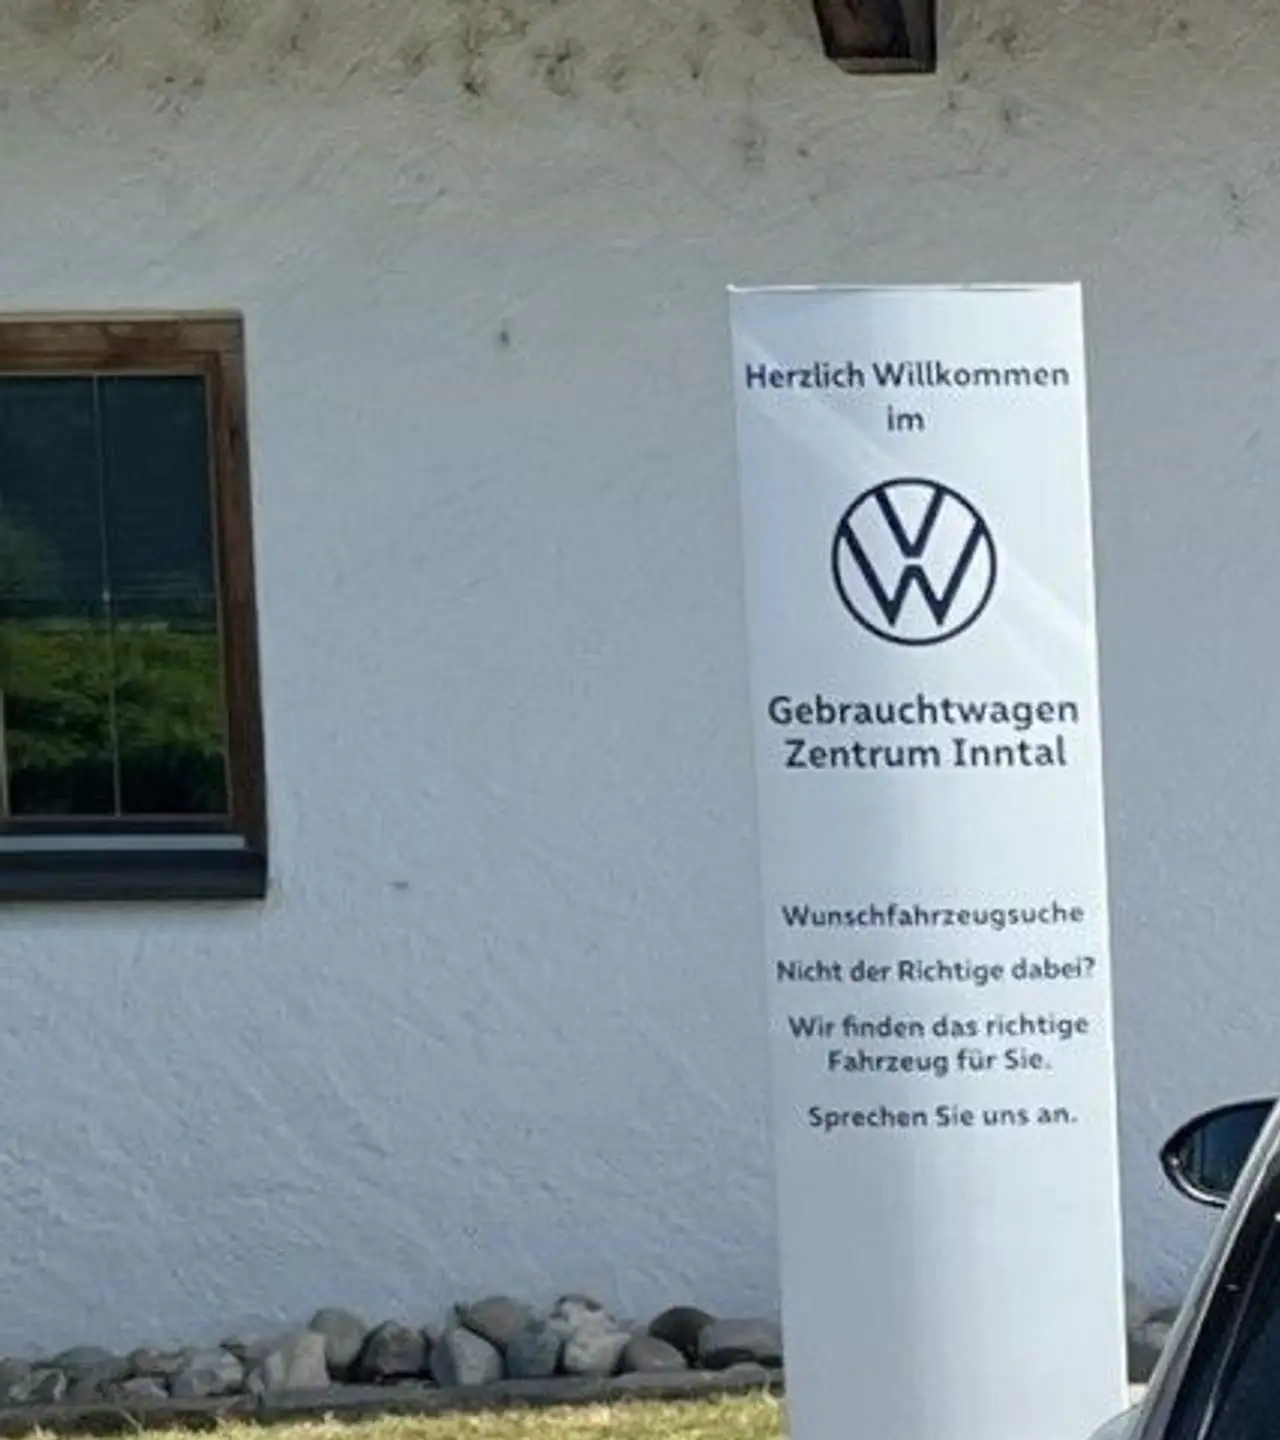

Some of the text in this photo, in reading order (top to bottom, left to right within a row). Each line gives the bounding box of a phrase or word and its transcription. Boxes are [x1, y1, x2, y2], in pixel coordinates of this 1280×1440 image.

[745, 360, 1069, 389] Herzlich Willkommen
[887, 405, 925, 431] im
[831, 477, 997, 646] VW
[768, 693, 1079, 730] Gebrauchtwagen
[785, 734, 1067, 769] Zentrum Inntal
[782, 900, 1085, 930] Wunschfahrzeugsuche
[776, 956, 1097, 987] Nicht der Richtige dabei?
[788, 1013, 1089, 1040] Wir finden das richtige
[828, 1047, 1051, 1078] Fahrzeug für Sie.
[808, 1105, 1077, 1132] Sprechen Sie uns an.
